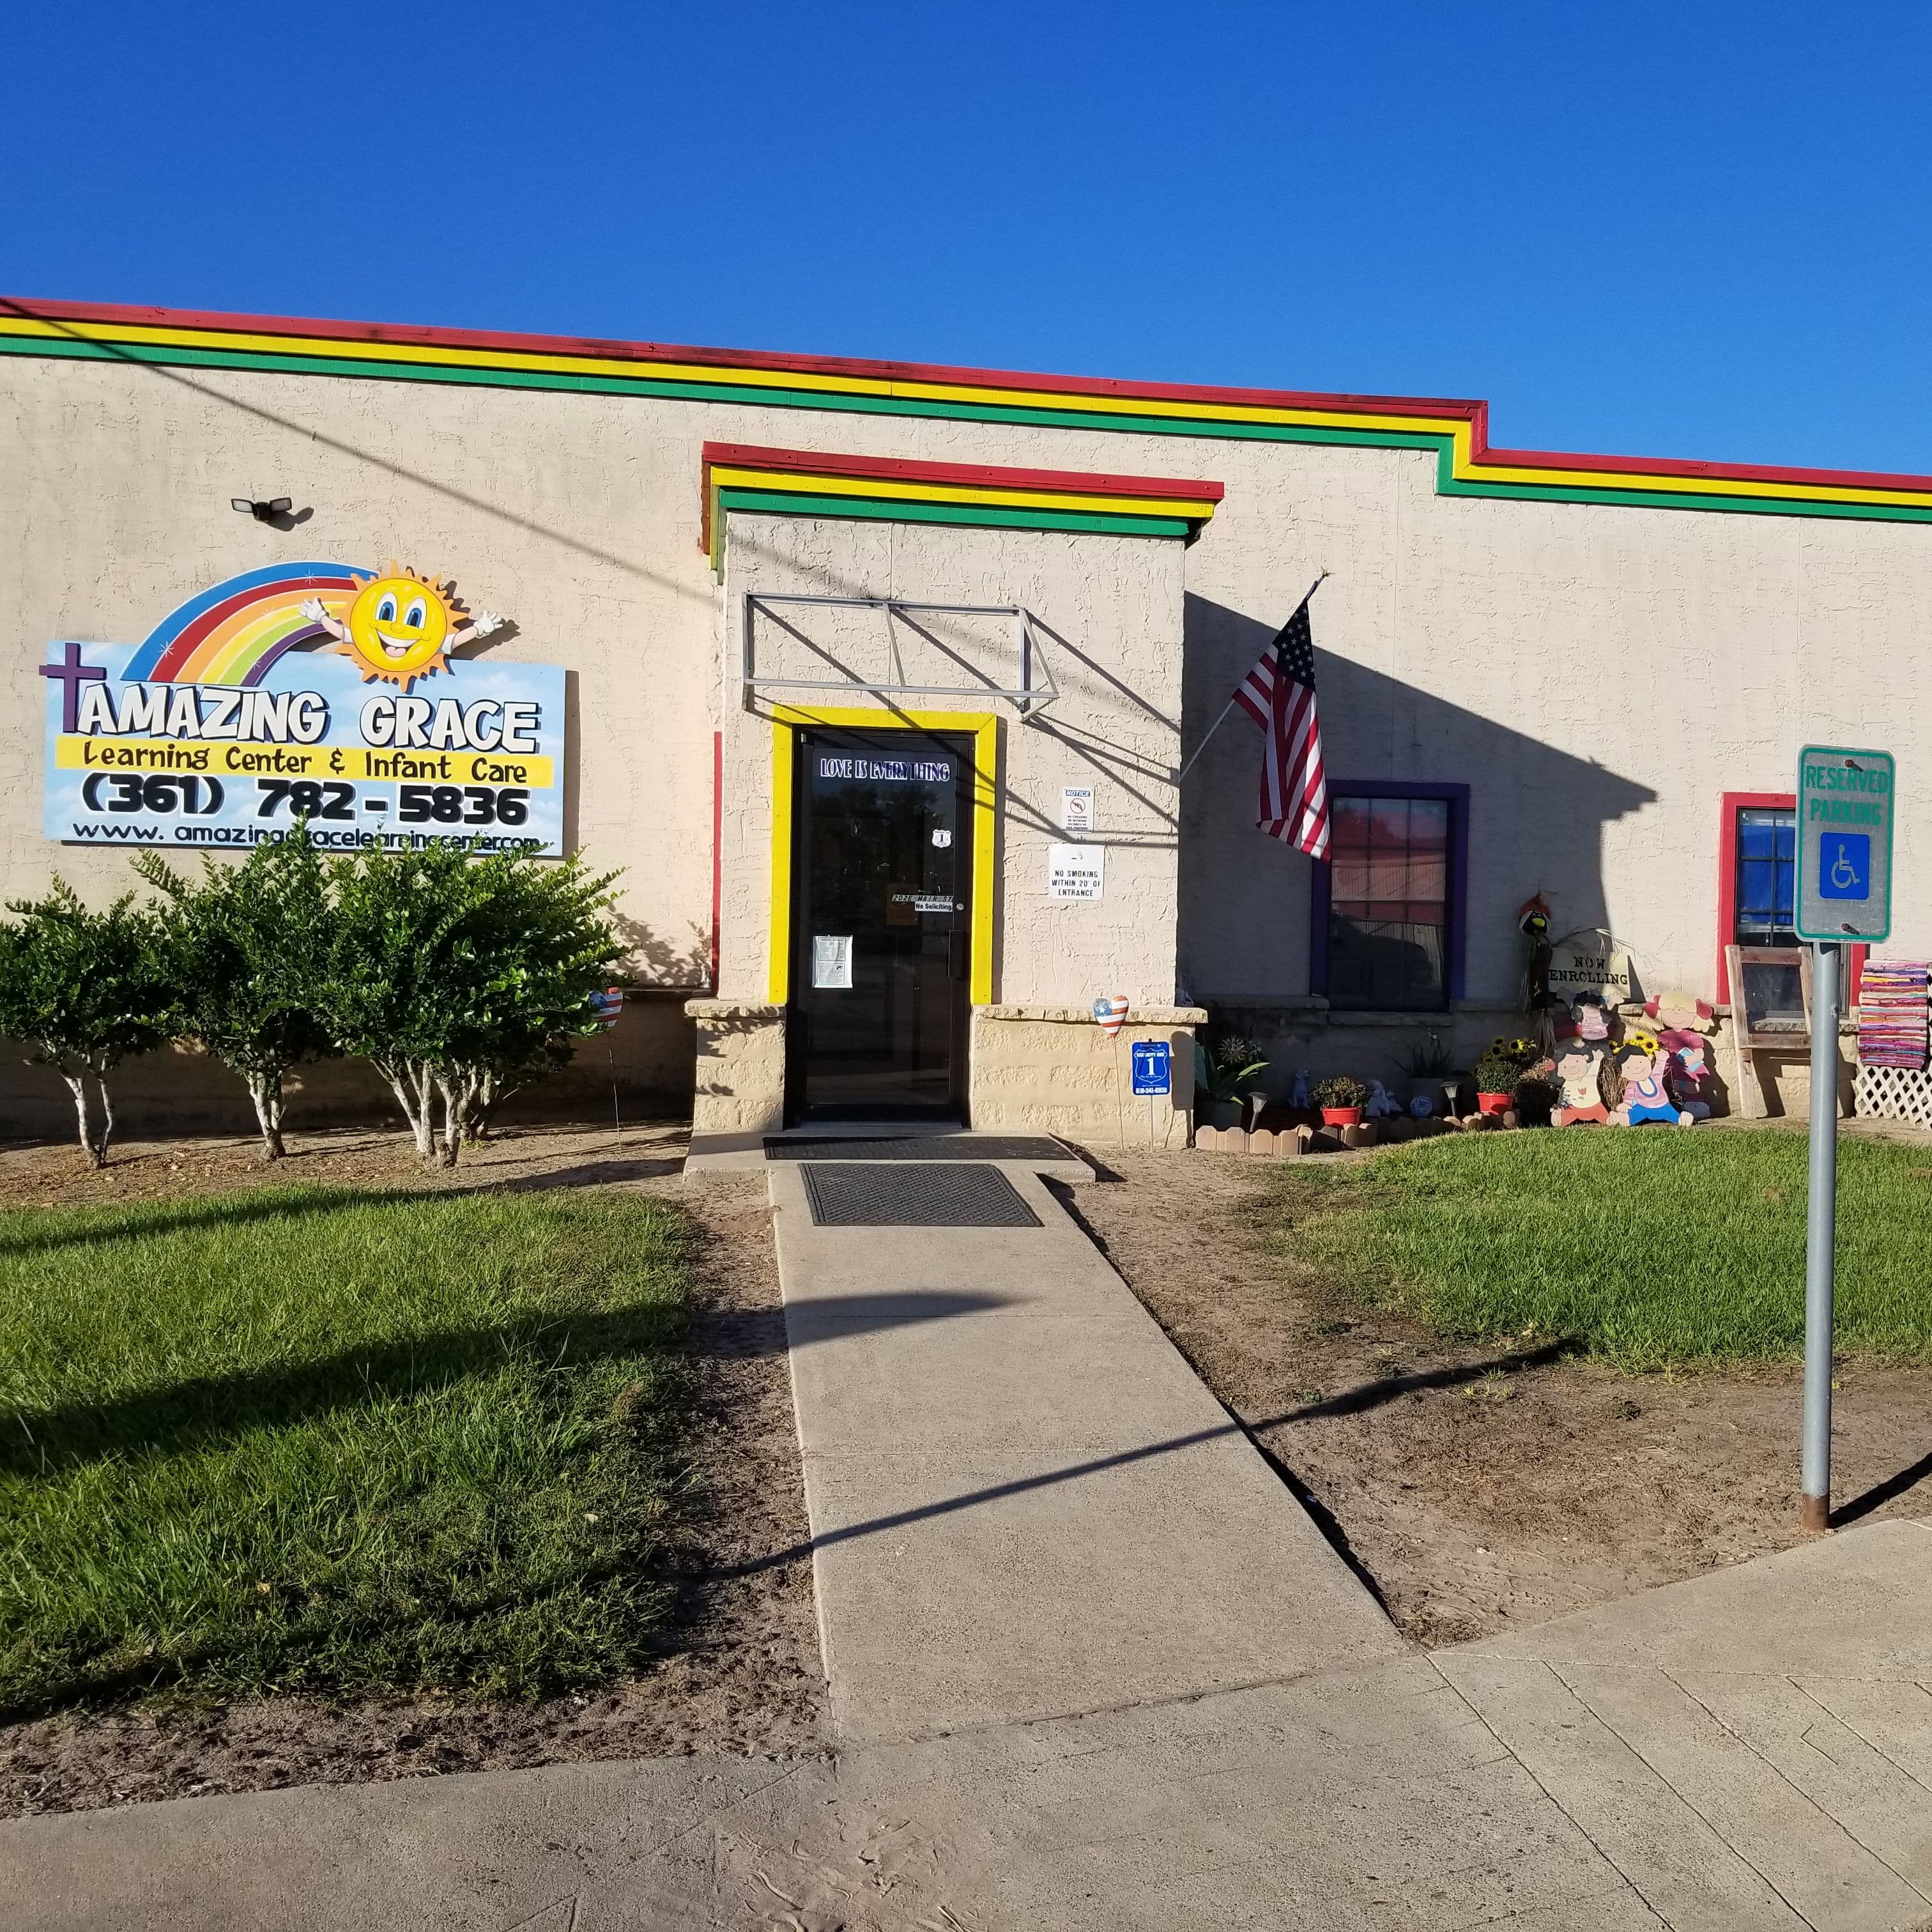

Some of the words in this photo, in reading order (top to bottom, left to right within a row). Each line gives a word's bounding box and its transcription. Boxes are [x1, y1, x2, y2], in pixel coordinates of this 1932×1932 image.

[77, 682, 330, 745] AMAZING
[360, 696, 540, 754] GRACE
[84, 740, 211, 770] Learning
[226, 746, 312, 773] Center
[329, 747, 346, 775] &
[366, 751, 452, 779] Infant
[471, 757, 527, 783] Care
[820, 758, 852, 778] LOVE
[855, 760, 868, 779] IS
[870, 760, 950, 781] EVERYTHING
[1806, 765, 1888, 793] RESERVED
[82, 772, 225, 815] (361)
[1810, 799, 1882, 825] PARKING
[1574, 955, 1606, 970] NOW
[1549, 969, 1628, 985] ENROLLING
[1147, 1057, 1155, 1076] 1
